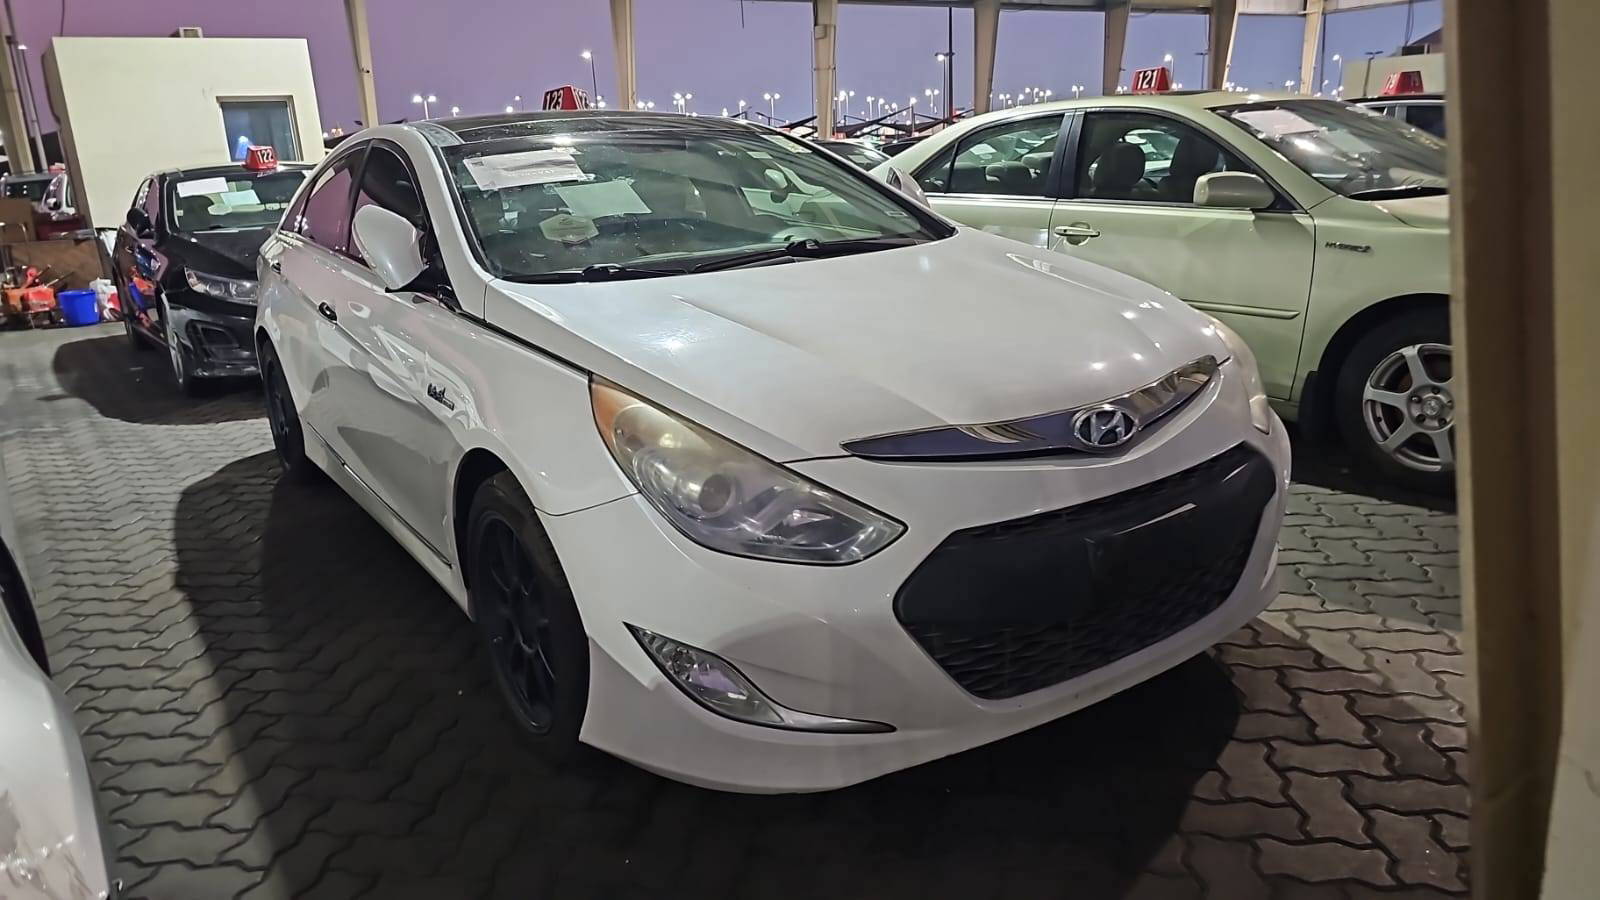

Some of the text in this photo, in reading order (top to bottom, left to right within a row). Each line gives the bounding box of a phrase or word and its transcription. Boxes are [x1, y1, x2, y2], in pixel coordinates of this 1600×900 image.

[1137, 70, 1158, 90] 121
[546, 89, 564, 110] 123
[257, 149, 274, 164] 122
